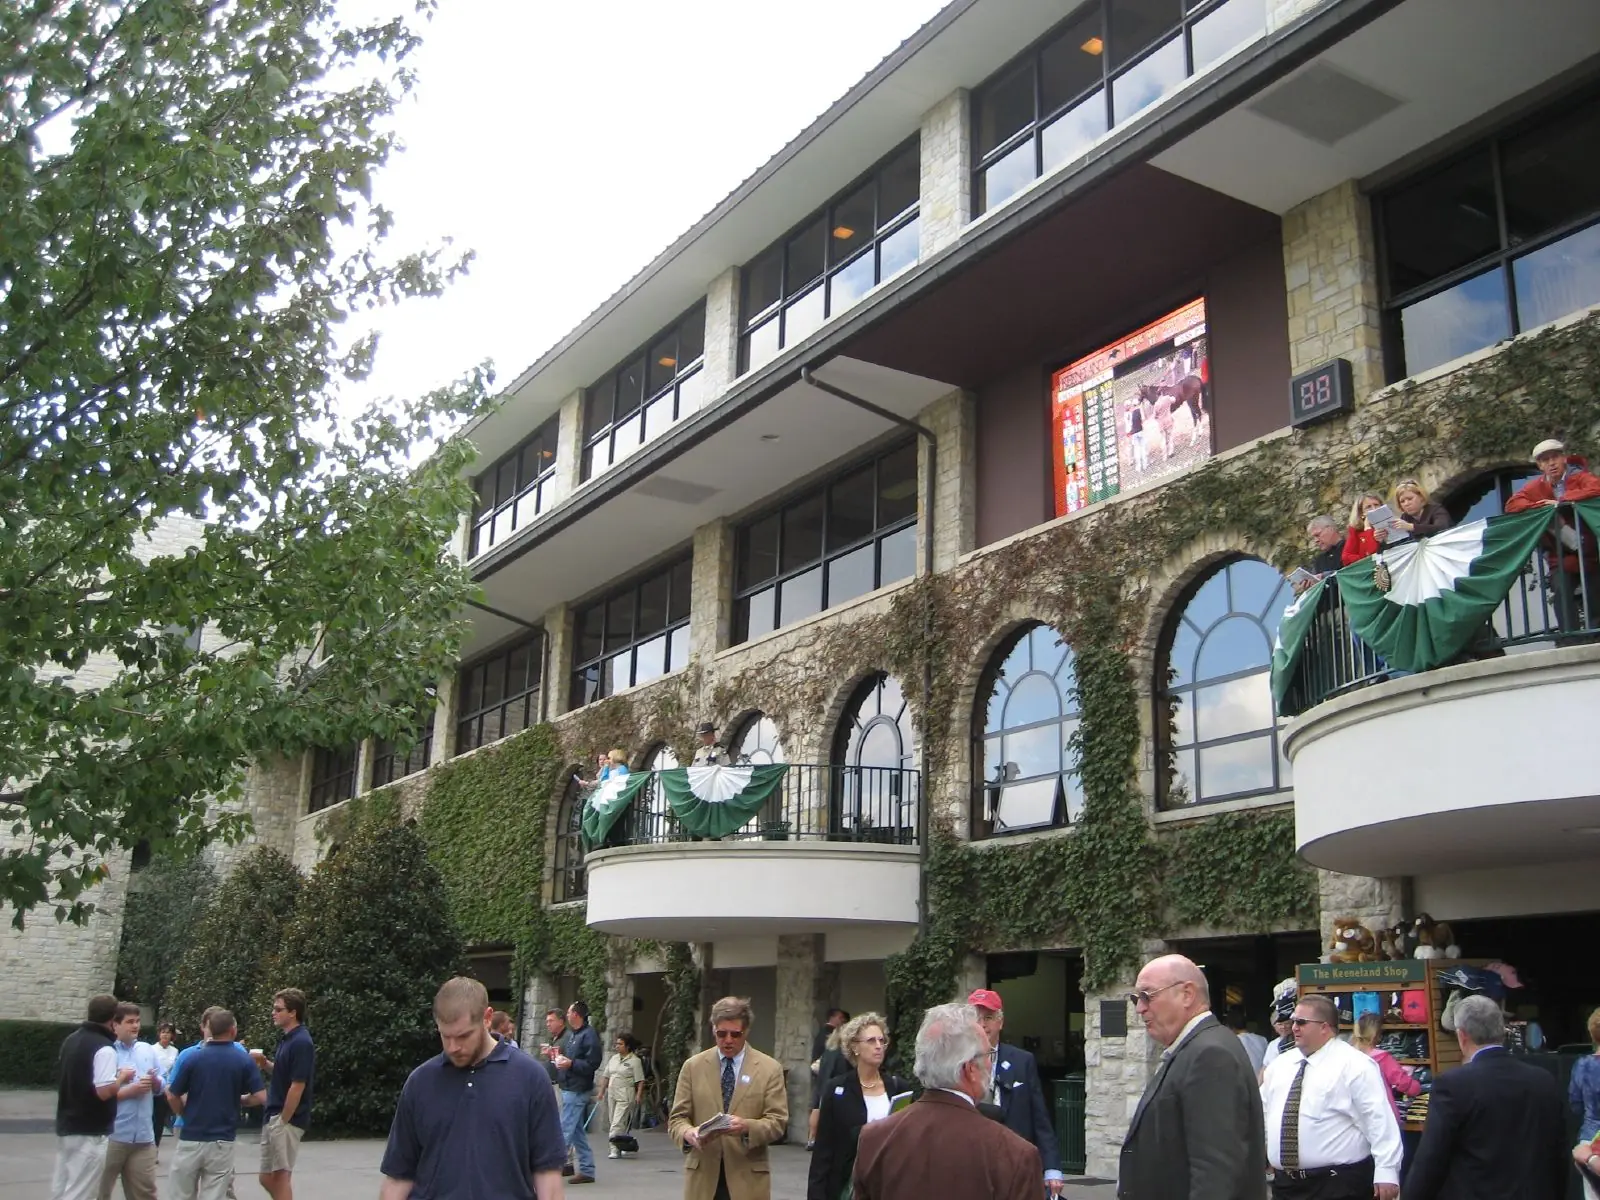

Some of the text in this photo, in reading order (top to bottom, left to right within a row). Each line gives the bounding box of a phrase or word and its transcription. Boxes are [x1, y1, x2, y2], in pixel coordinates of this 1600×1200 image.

[1313, 966, 1408, 979] The Keeneland Shop
